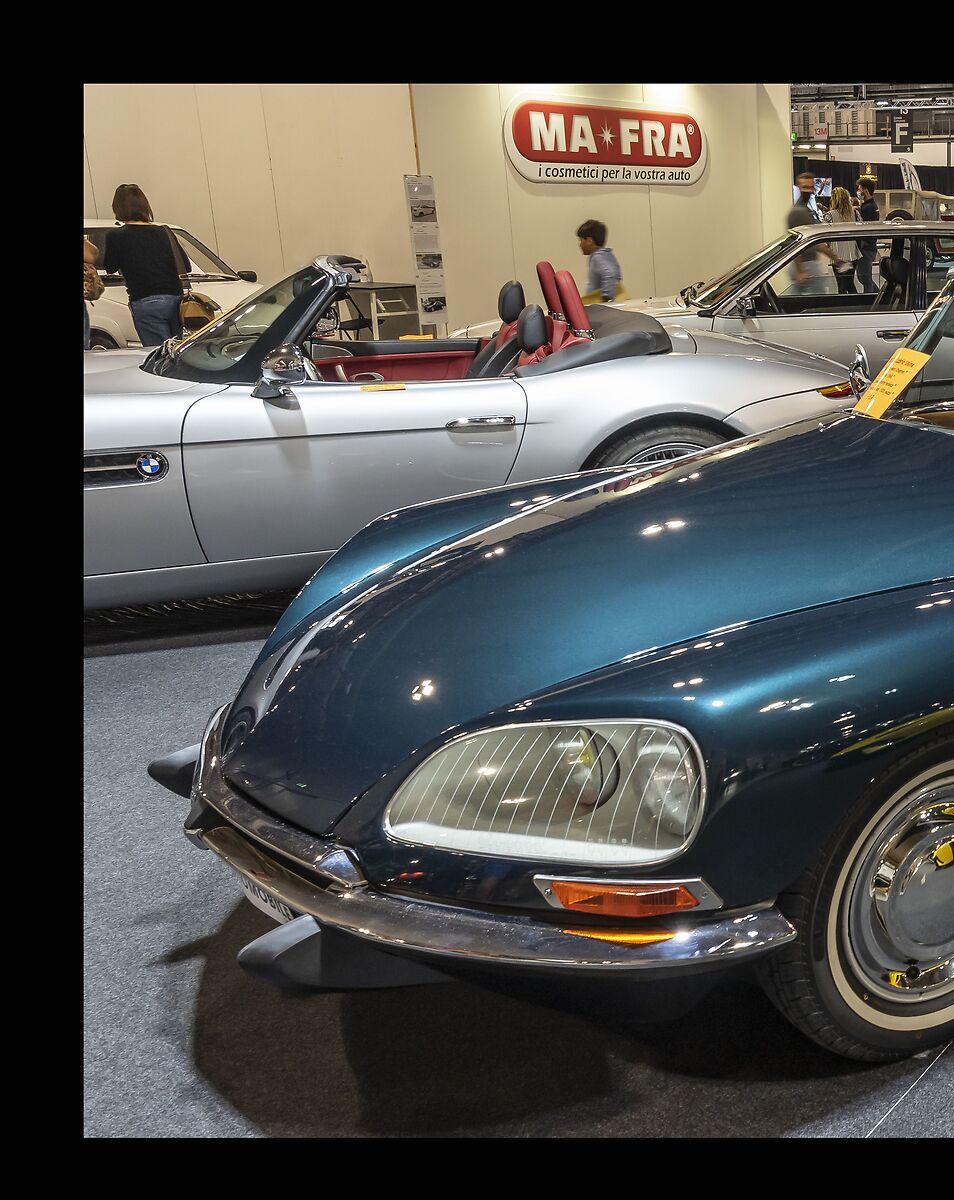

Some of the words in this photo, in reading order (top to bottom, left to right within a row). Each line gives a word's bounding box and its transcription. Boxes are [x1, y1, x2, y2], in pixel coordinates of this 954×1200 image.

[529, 111, 598, 154] MA
[815, 127, 828, 135] 13M
[895, 123, 909, 144] F
[538, 164, 542, 177] i
[545, 166, 599, 179] cosmetici
[601, 169, 620, 182] per
[622, 168, 632, 180] la
[634, 169, 666, 181] vostra
[668, 171, 691, 181] auto
